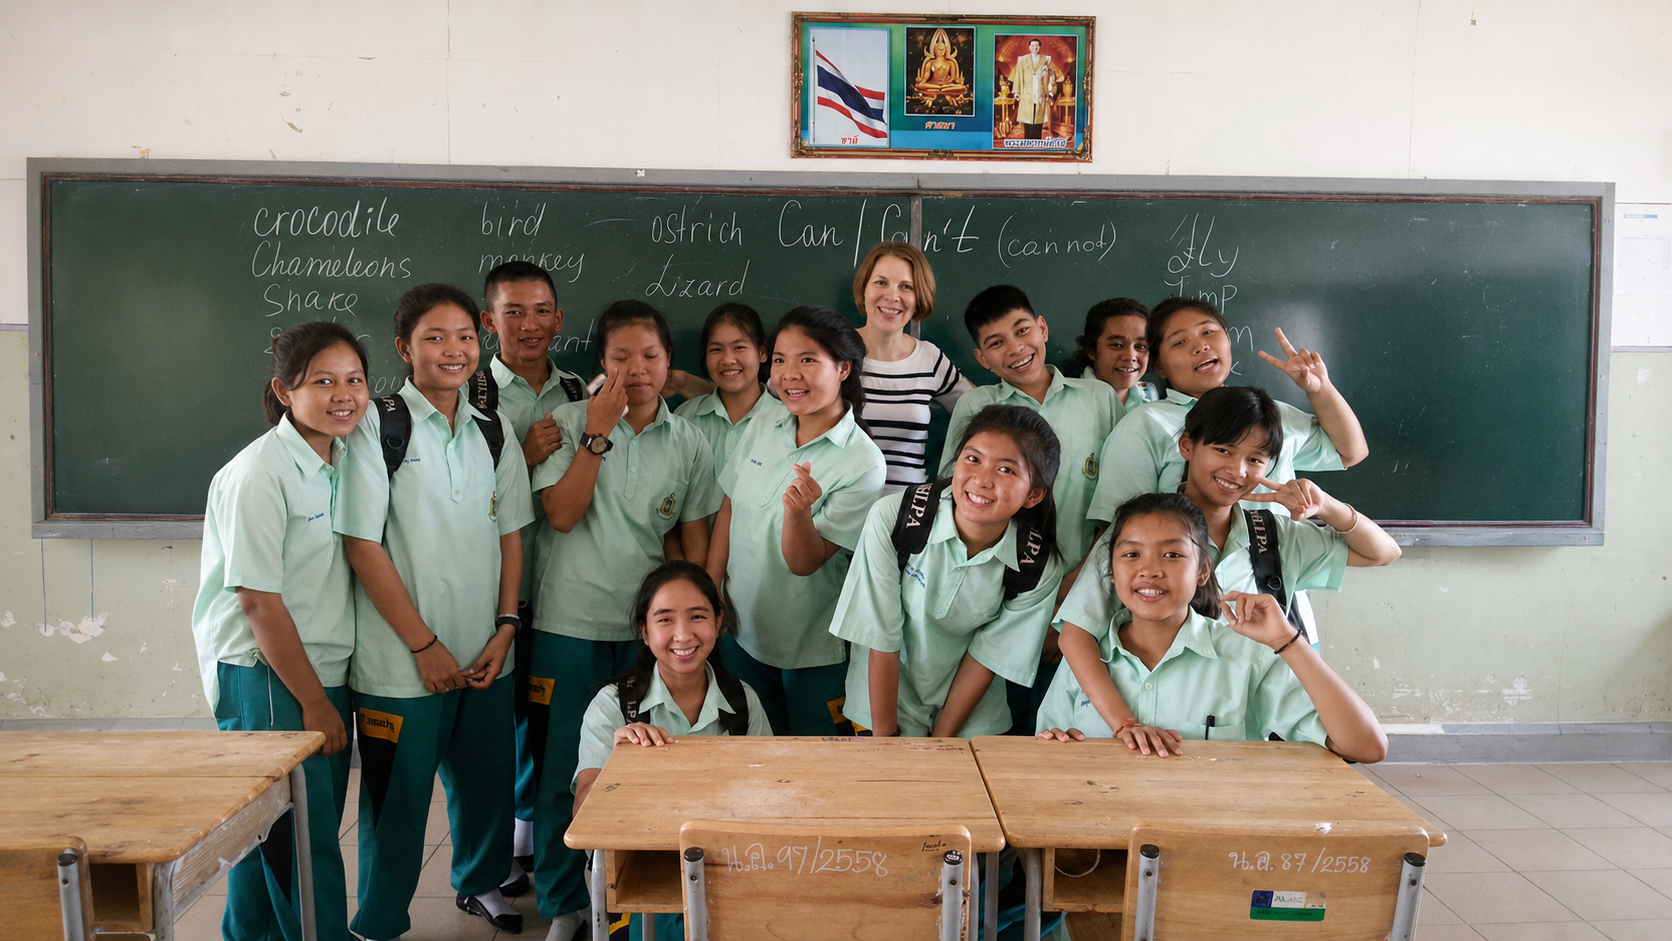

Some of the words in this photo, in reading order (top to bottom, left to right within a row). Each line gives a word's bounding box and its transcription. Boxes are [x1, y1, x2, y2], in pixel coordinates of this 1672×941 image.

[253, 196, 400, 239] crocodile
[481, 200, 547, 237] bird
[251, 239, 412, 279] Chameleons
[645, 253, 751, 298] Lizard
[263, 283, 358, 319] Snake
